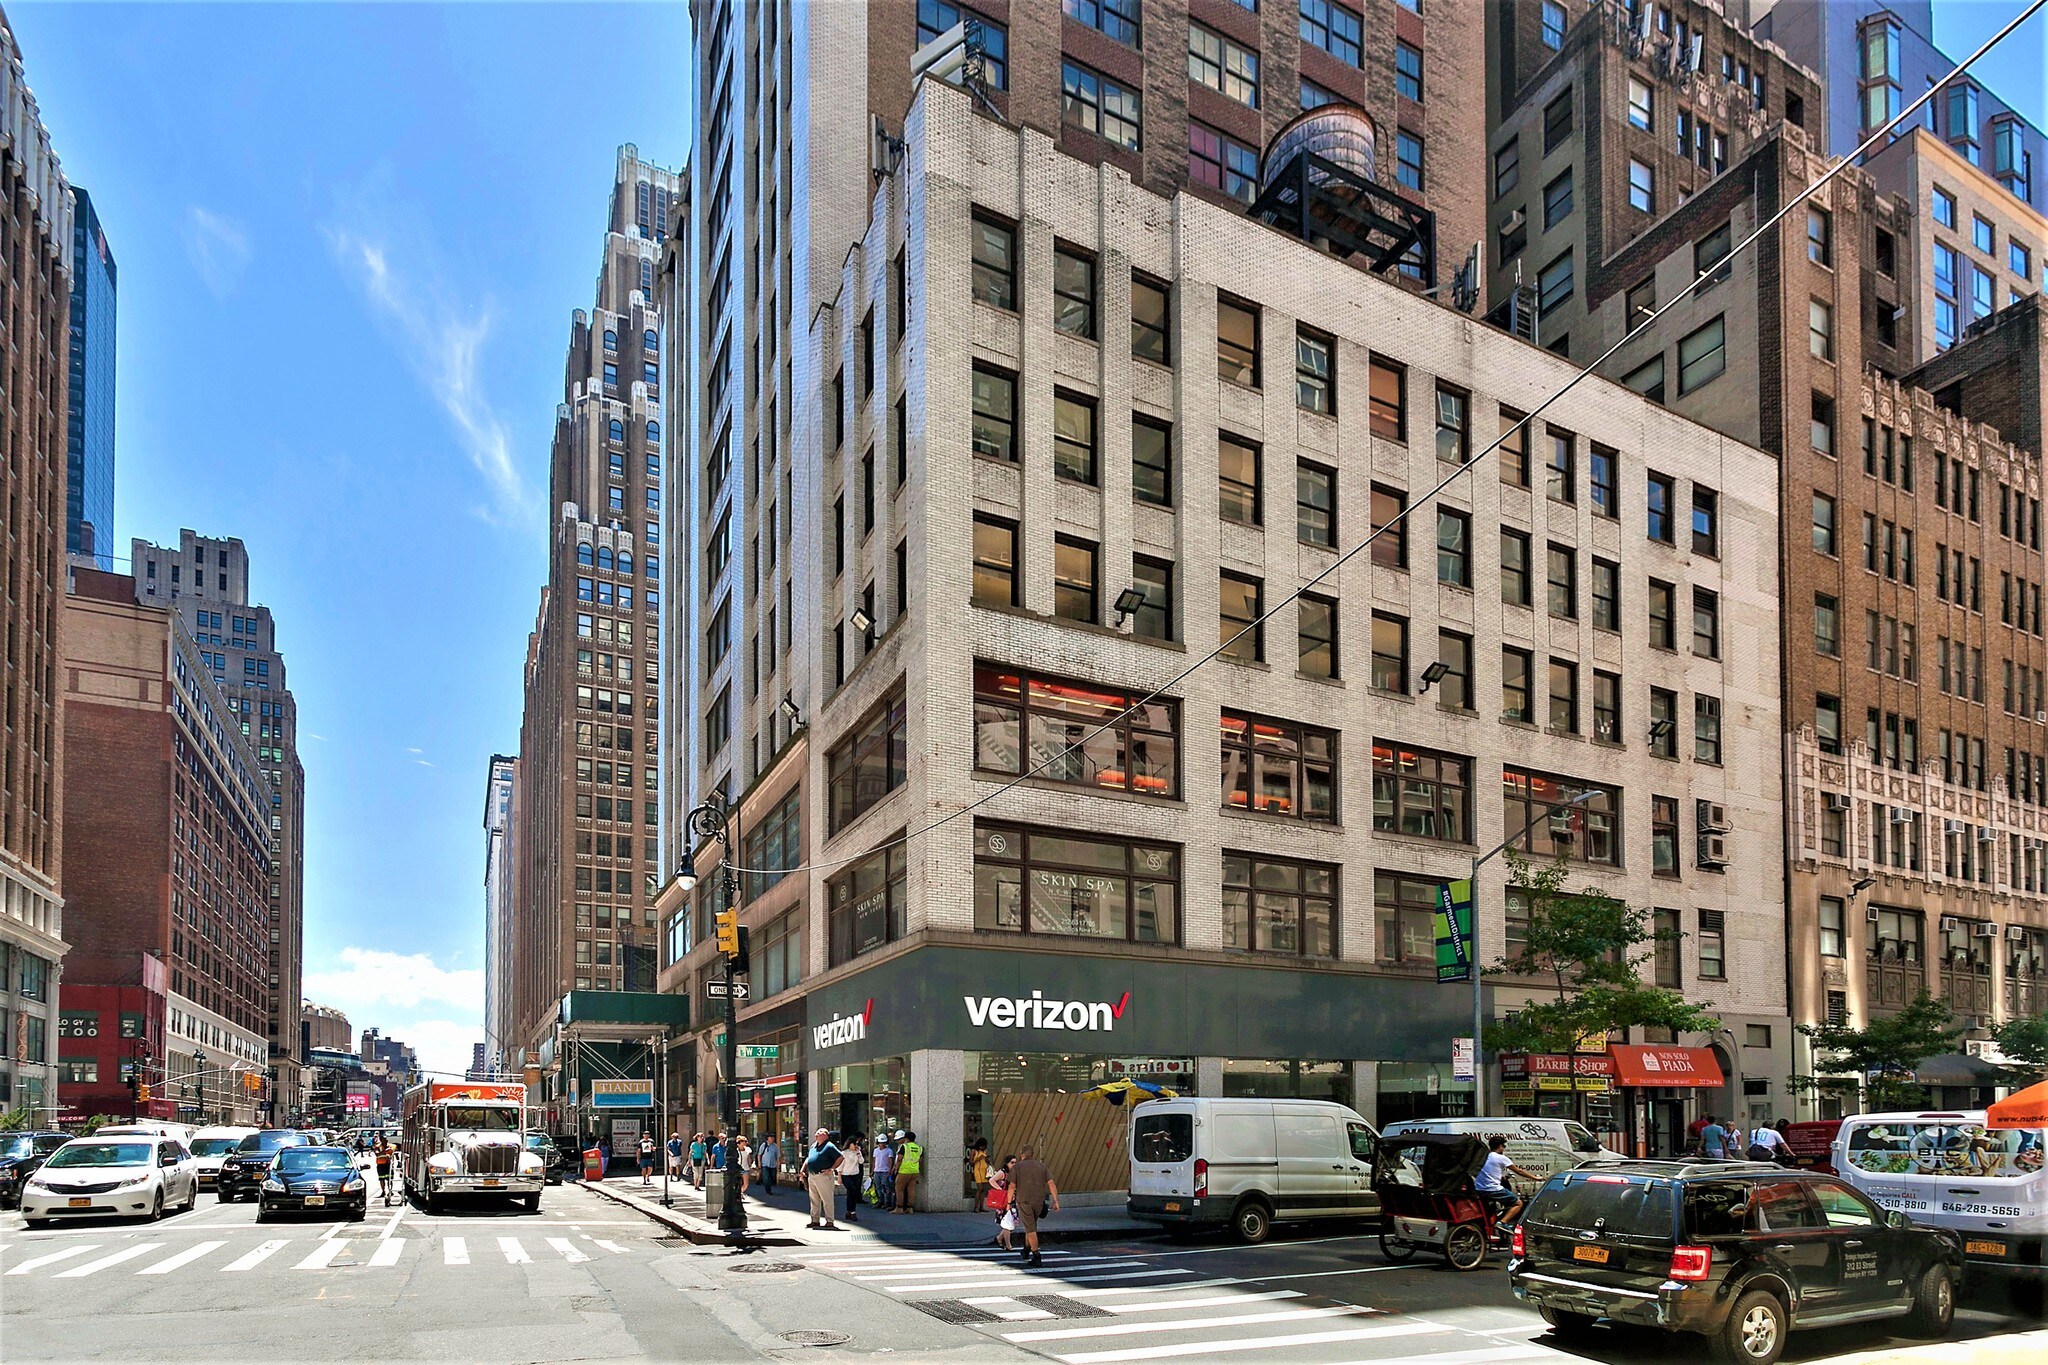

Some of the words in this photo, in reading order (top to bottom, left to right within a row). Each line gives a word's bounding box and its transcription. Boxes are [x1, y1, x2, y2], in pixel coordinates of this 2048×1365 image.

[1041, 874, 1077, 888] SKIN
[1086, 879, 1114, 891] SPA
[856, 899, 871, 914] SKIN
[872, 892, 885, 905] SPA
[1442, 890, 1463, 956] #GarmentDistrict
[963, 990, 1113, 1031] verizon
[812, 1012, 866, 1050] verizon
[746, 1048, 753, 1056] W
[757, 1048, 768, 1056] 37
[1659, 1052, 1673, 1060] NON
[1673, 1052, 1689, 1060] SOLO
[1580, 1059, 1608, 1071] SHOP
[1662, 1060, 1694, 1072] PIADA
[600, 1083, 646, 1092] TIANTI
[1918, 1148, 1960, 1156] BLC
[1942, 1203, 2020, 1217] 646-289-5656
[1862, 1261, 1876, 1269] Street
